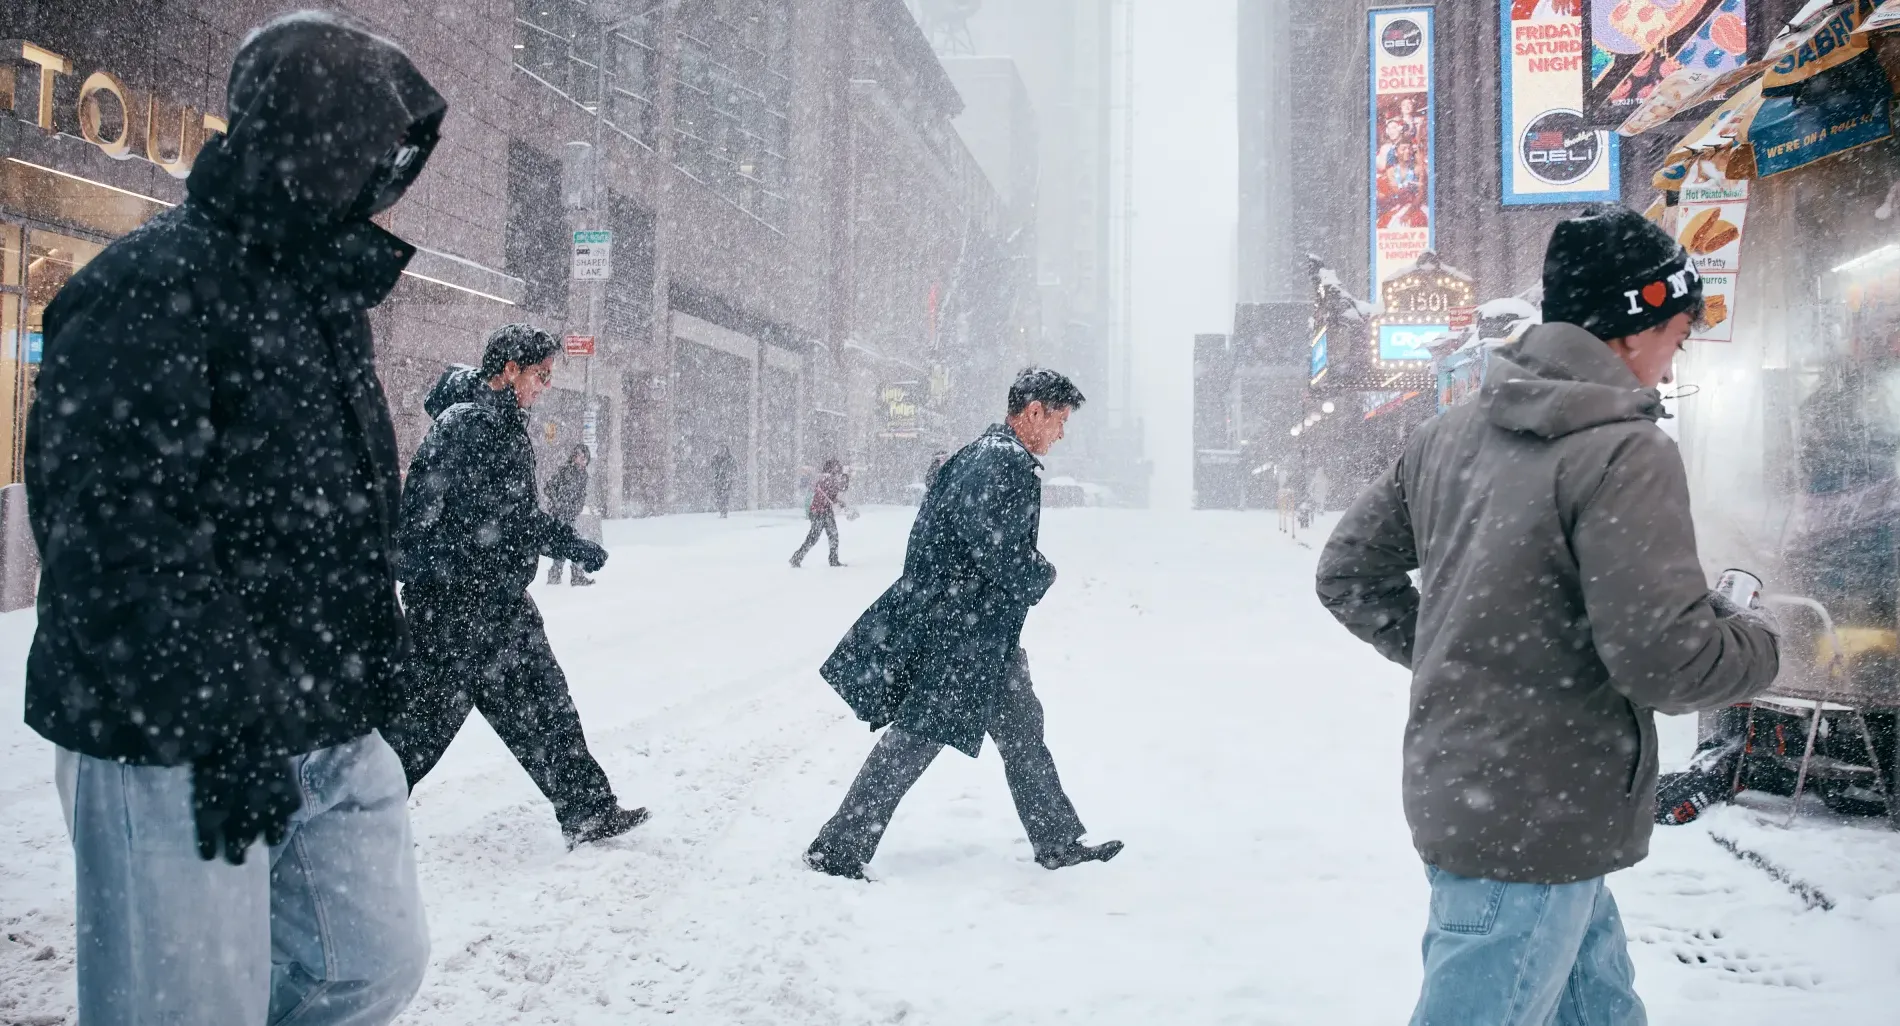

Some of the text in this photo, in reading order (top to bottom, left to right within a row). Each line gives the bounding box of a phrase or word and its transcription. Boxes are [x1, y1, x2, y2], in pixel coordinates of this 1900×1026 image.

[1515, 24, 1582, 41] FRIDAY
[1384, 39, 1420, 48] DELI
[1515, 39, 1582, 56] SATURD
[1380, 64, 1424, 77] SATIN
[1378, 77, 1426, 89] DOLLZ
[22, 40, 230, 178] TOU
[1766, 139, 1800, 159] WE'RE
[1803, 132, 1818, 147] ON
[1819, 128, 1827, 139] A
[1830, 119, 1857, 135] ROLL
[1528, 148, 1592, 163] DELI
[1686, 189, 1698, 200] Hot
[1707, 258, 1726, 269] Patty
[580, 268, 602, 276] LANE
[1701, 274, 1728, 285] hurros
[1410, 292, 1448, 312] 1501
[1624, 290, 1644, 315] I
